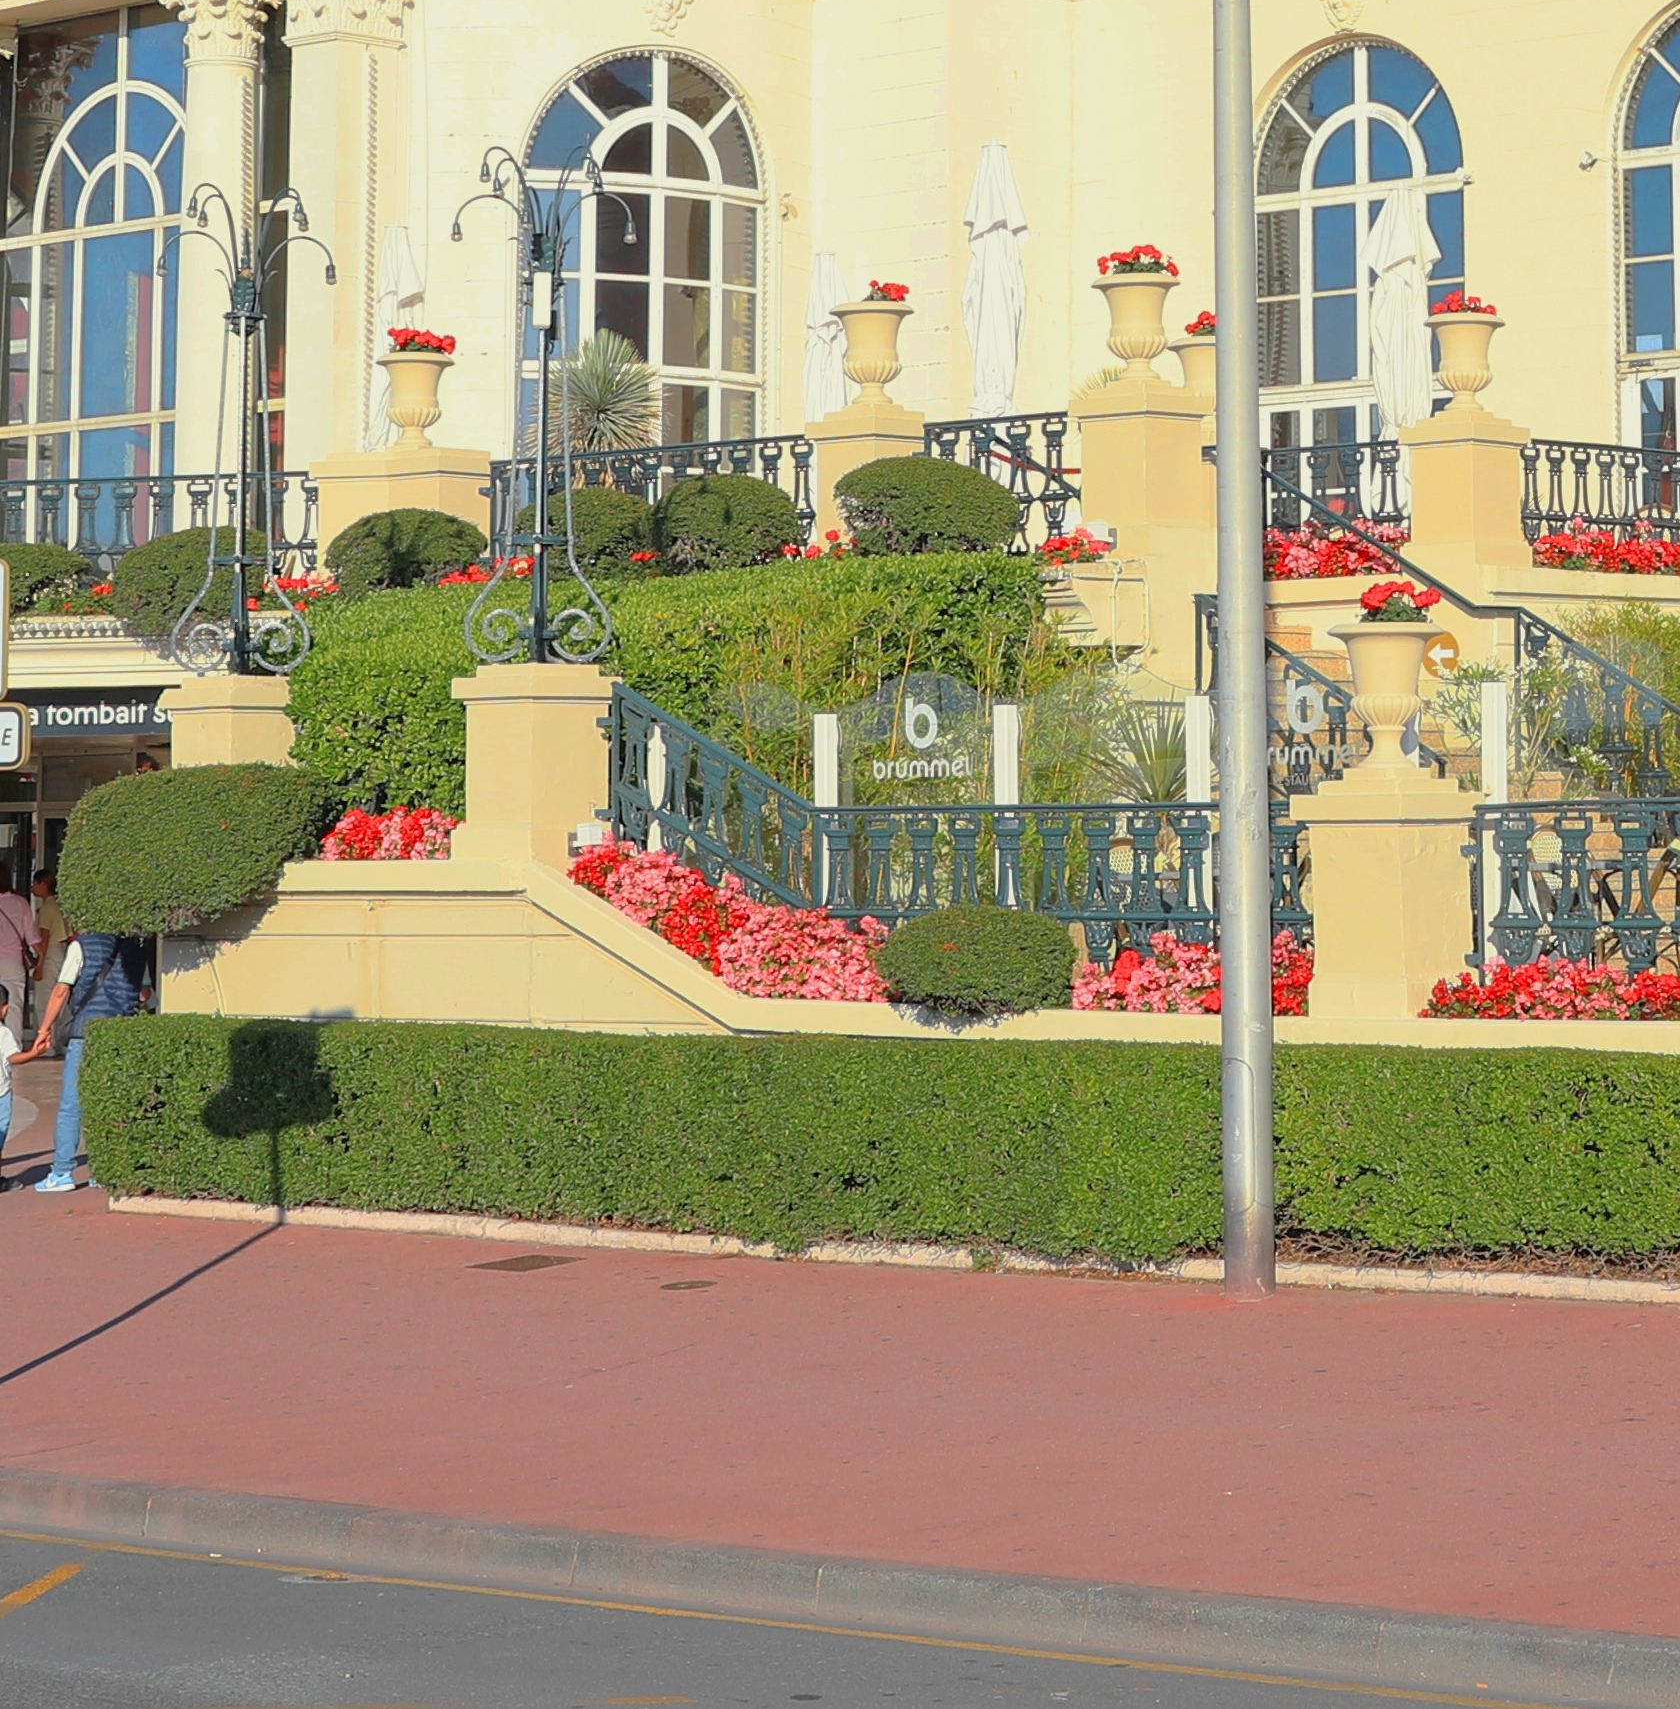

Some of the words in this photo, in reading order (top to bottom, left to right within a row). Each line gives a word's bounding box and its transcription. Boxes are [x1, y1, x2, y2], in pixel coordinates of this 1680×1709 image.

[46, 698, 149, 727] tombait
[905, 697, 938, 748] b
[1286, 679, 1324, 734] b
[873, 752, 972, 780] brummel
